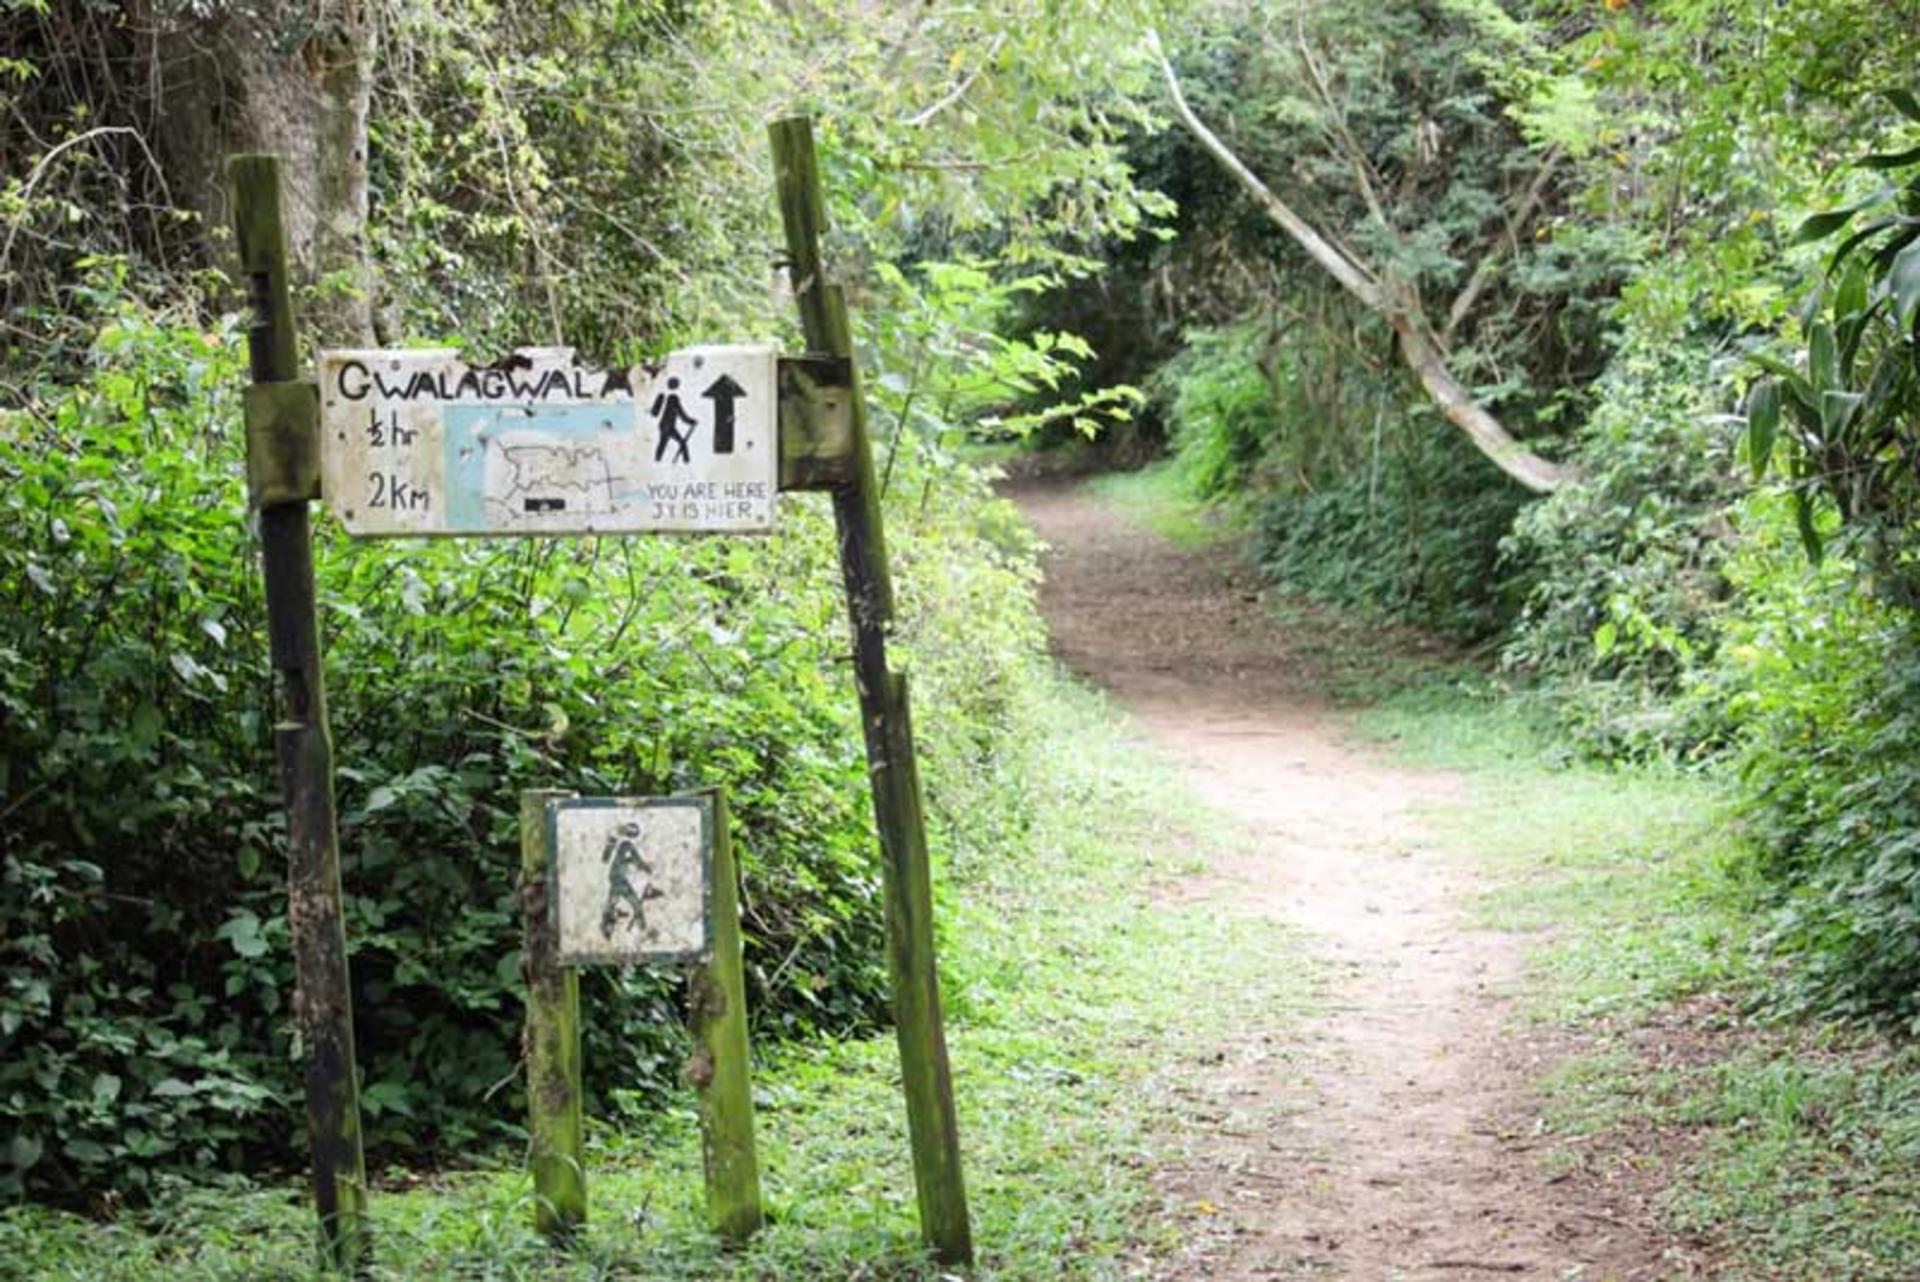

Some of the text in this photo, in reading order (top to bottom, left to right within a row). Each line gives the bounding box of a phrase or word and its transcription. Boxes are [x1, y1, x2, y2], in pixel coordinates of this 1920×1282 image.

[338, 359, 634, 401] GWALAGWALA
[648, 482, 766, 500] YOU ARE HERE
[683, 501, 699, 519] IS
[705, 501, 752, 519] HIER
